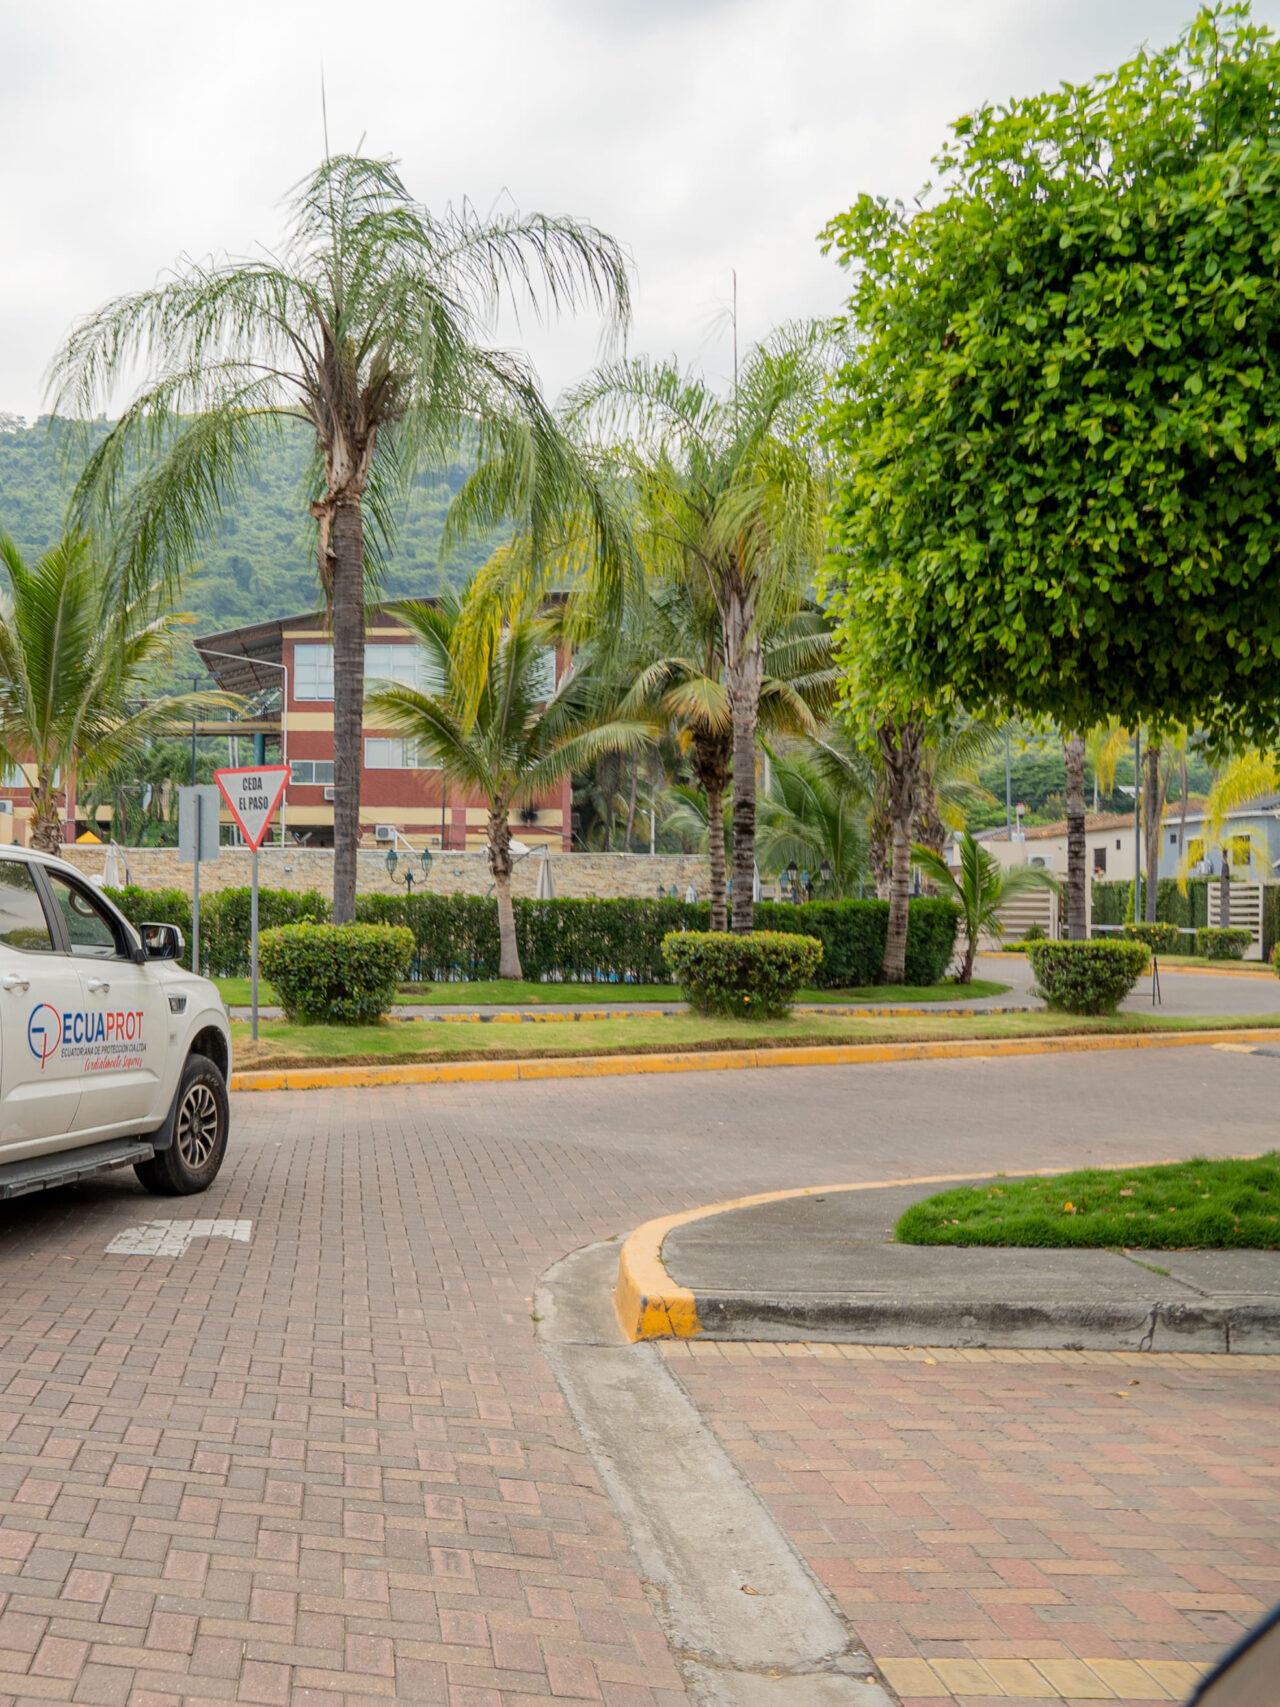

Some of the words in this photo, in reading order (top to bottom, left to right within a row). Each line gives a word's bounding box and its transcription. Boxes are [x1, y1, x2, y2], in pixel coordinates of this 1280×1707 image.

[242, 777, 263, 791] CEDA
[239, 797, 247, 811] EL
[248, 796, 268, 811] PASO
[62, 1011, 144, 1044] ECUAPROT
[94, 1046, 101, 1056] DE
